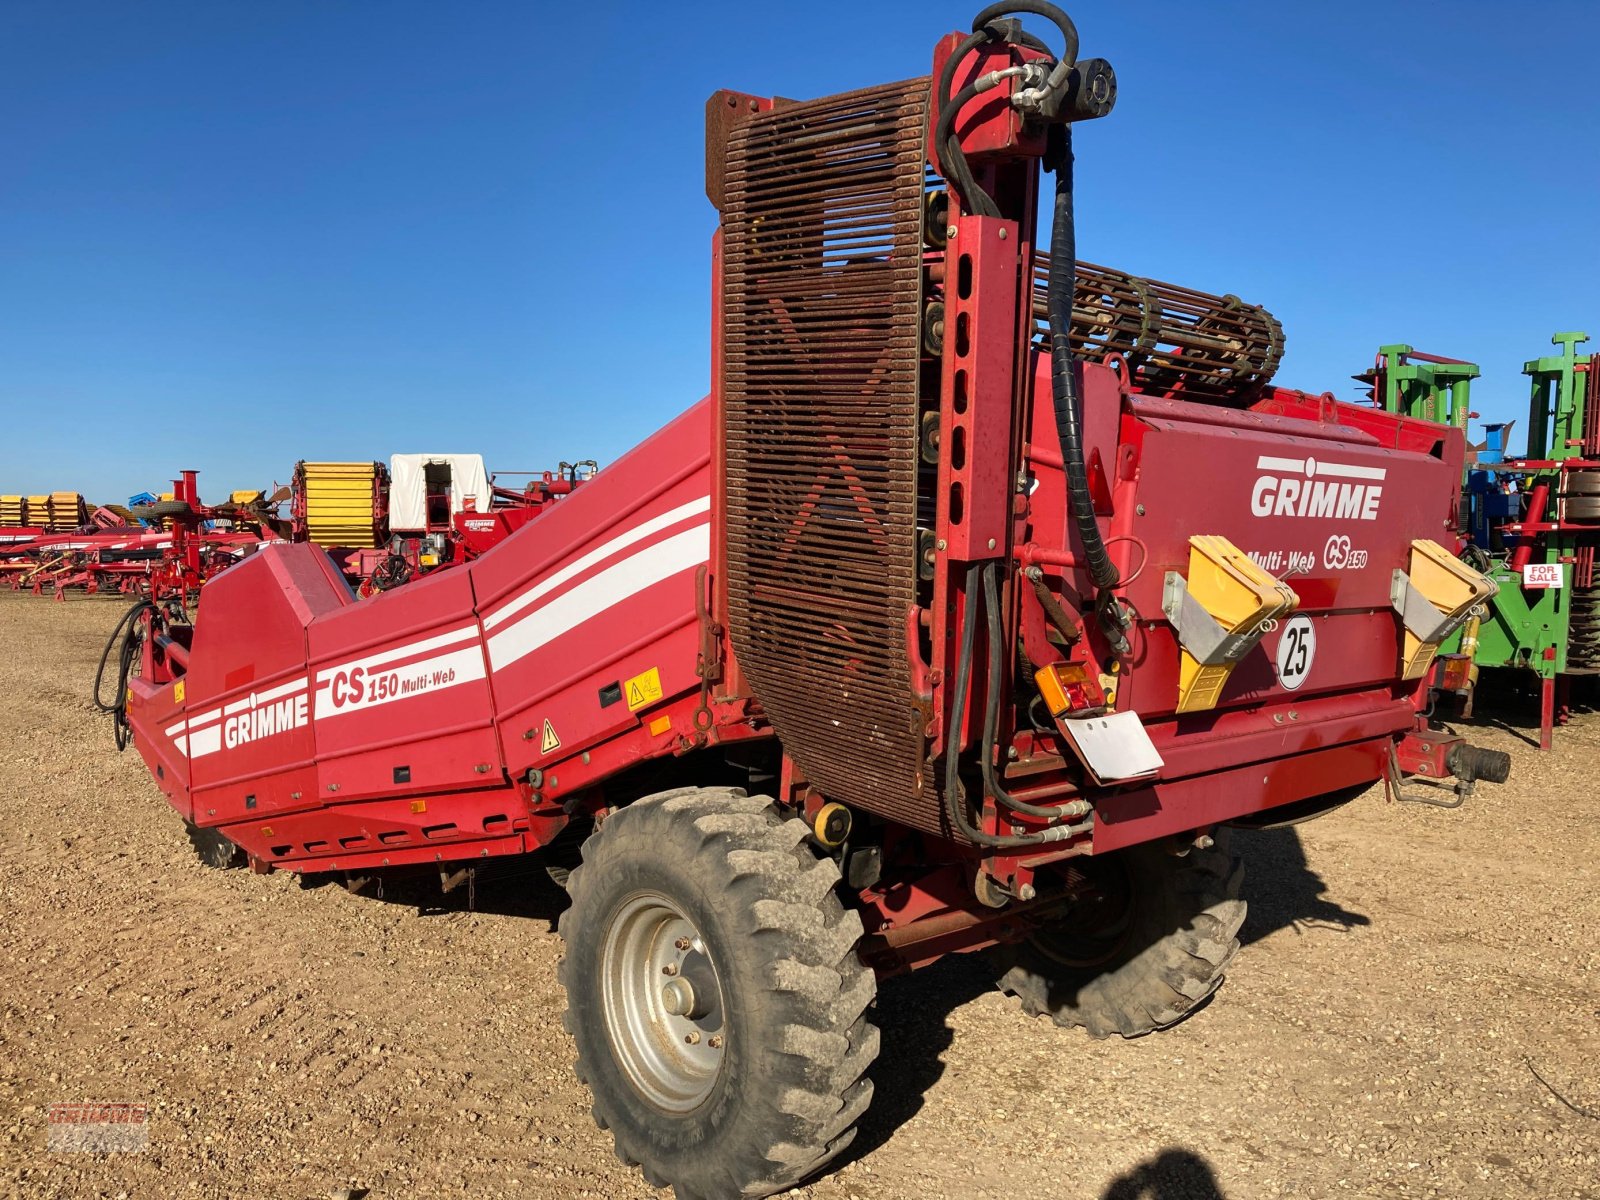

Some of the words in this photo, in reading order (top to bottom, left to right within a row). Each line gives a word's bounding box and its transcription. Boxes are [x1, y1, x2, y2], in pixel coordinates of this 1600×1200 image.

[1251, 457, 1383, 520] GRIMME
[1532, 566, 1555, 574] FOR
[1283, 627, 1310, 676] 25
[332, 667, 365, 708] CS
[368, 673, 399, 702] 150
[225, 693, 308, 749] GRIMME
